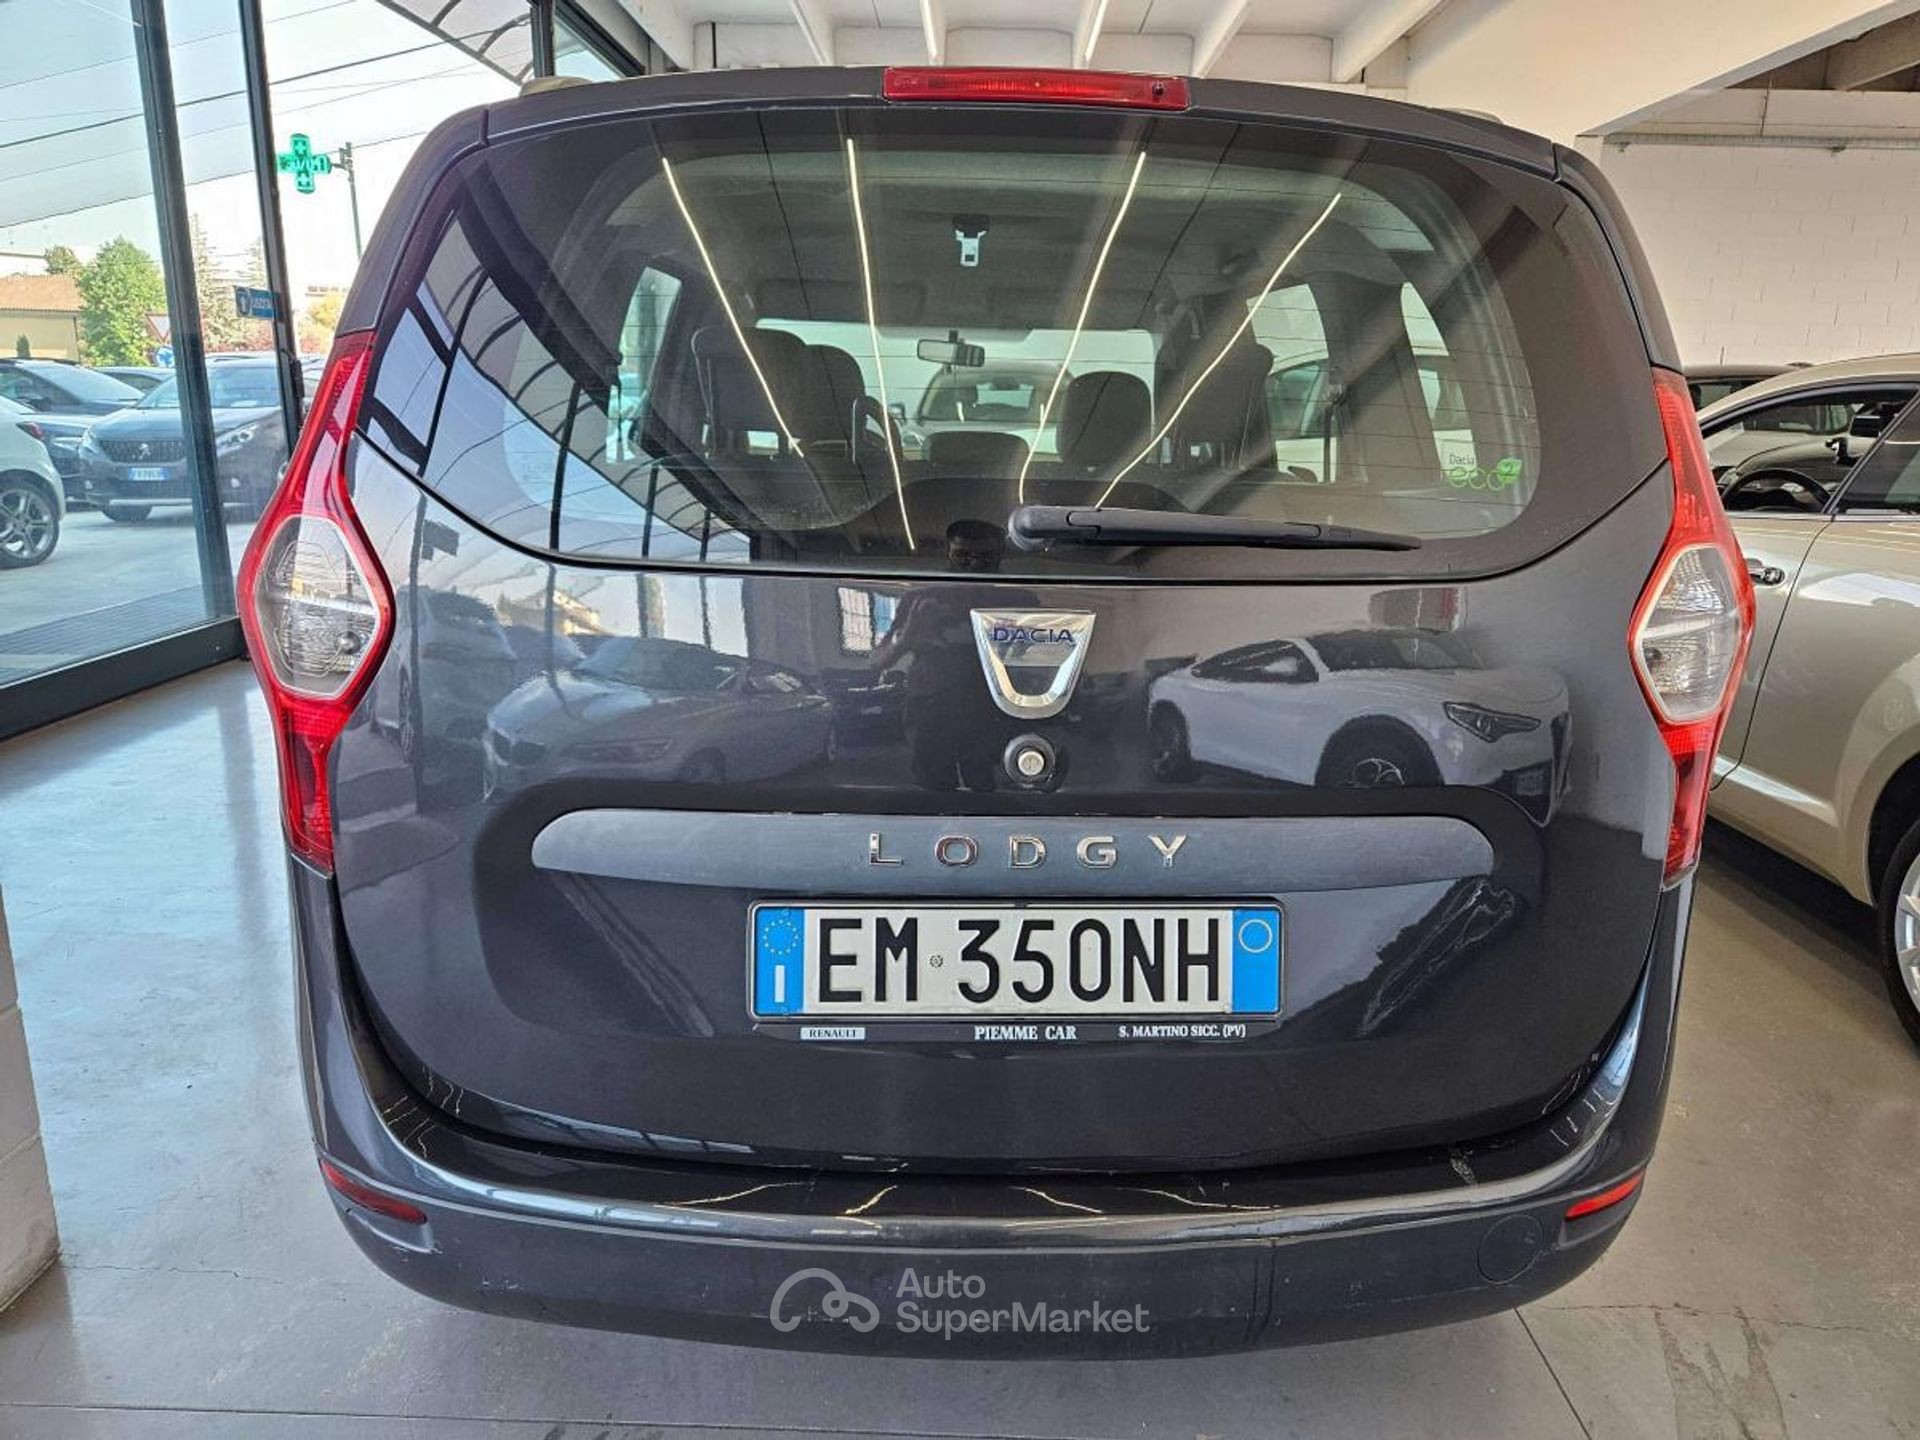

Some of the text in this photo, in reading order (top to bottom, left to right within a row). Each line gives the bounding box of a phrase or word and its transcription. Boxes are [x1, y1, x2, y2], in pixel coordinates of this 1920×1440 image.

[1449, 454, 1475, 466] Dacia
[993, 626, 1073, 643] DACIA
[869, 832, 1187, 868] LODGY
[808, 1028, 857, 1039] RENAULT
[974, 1025, 1078, 1040] PIEMME CAR
[1118, 1025, 1130, 1038] S.
[1132, 1025, 1189, 1037] MARTINO
[1222, 1023, 1246, 1038] (PV)
